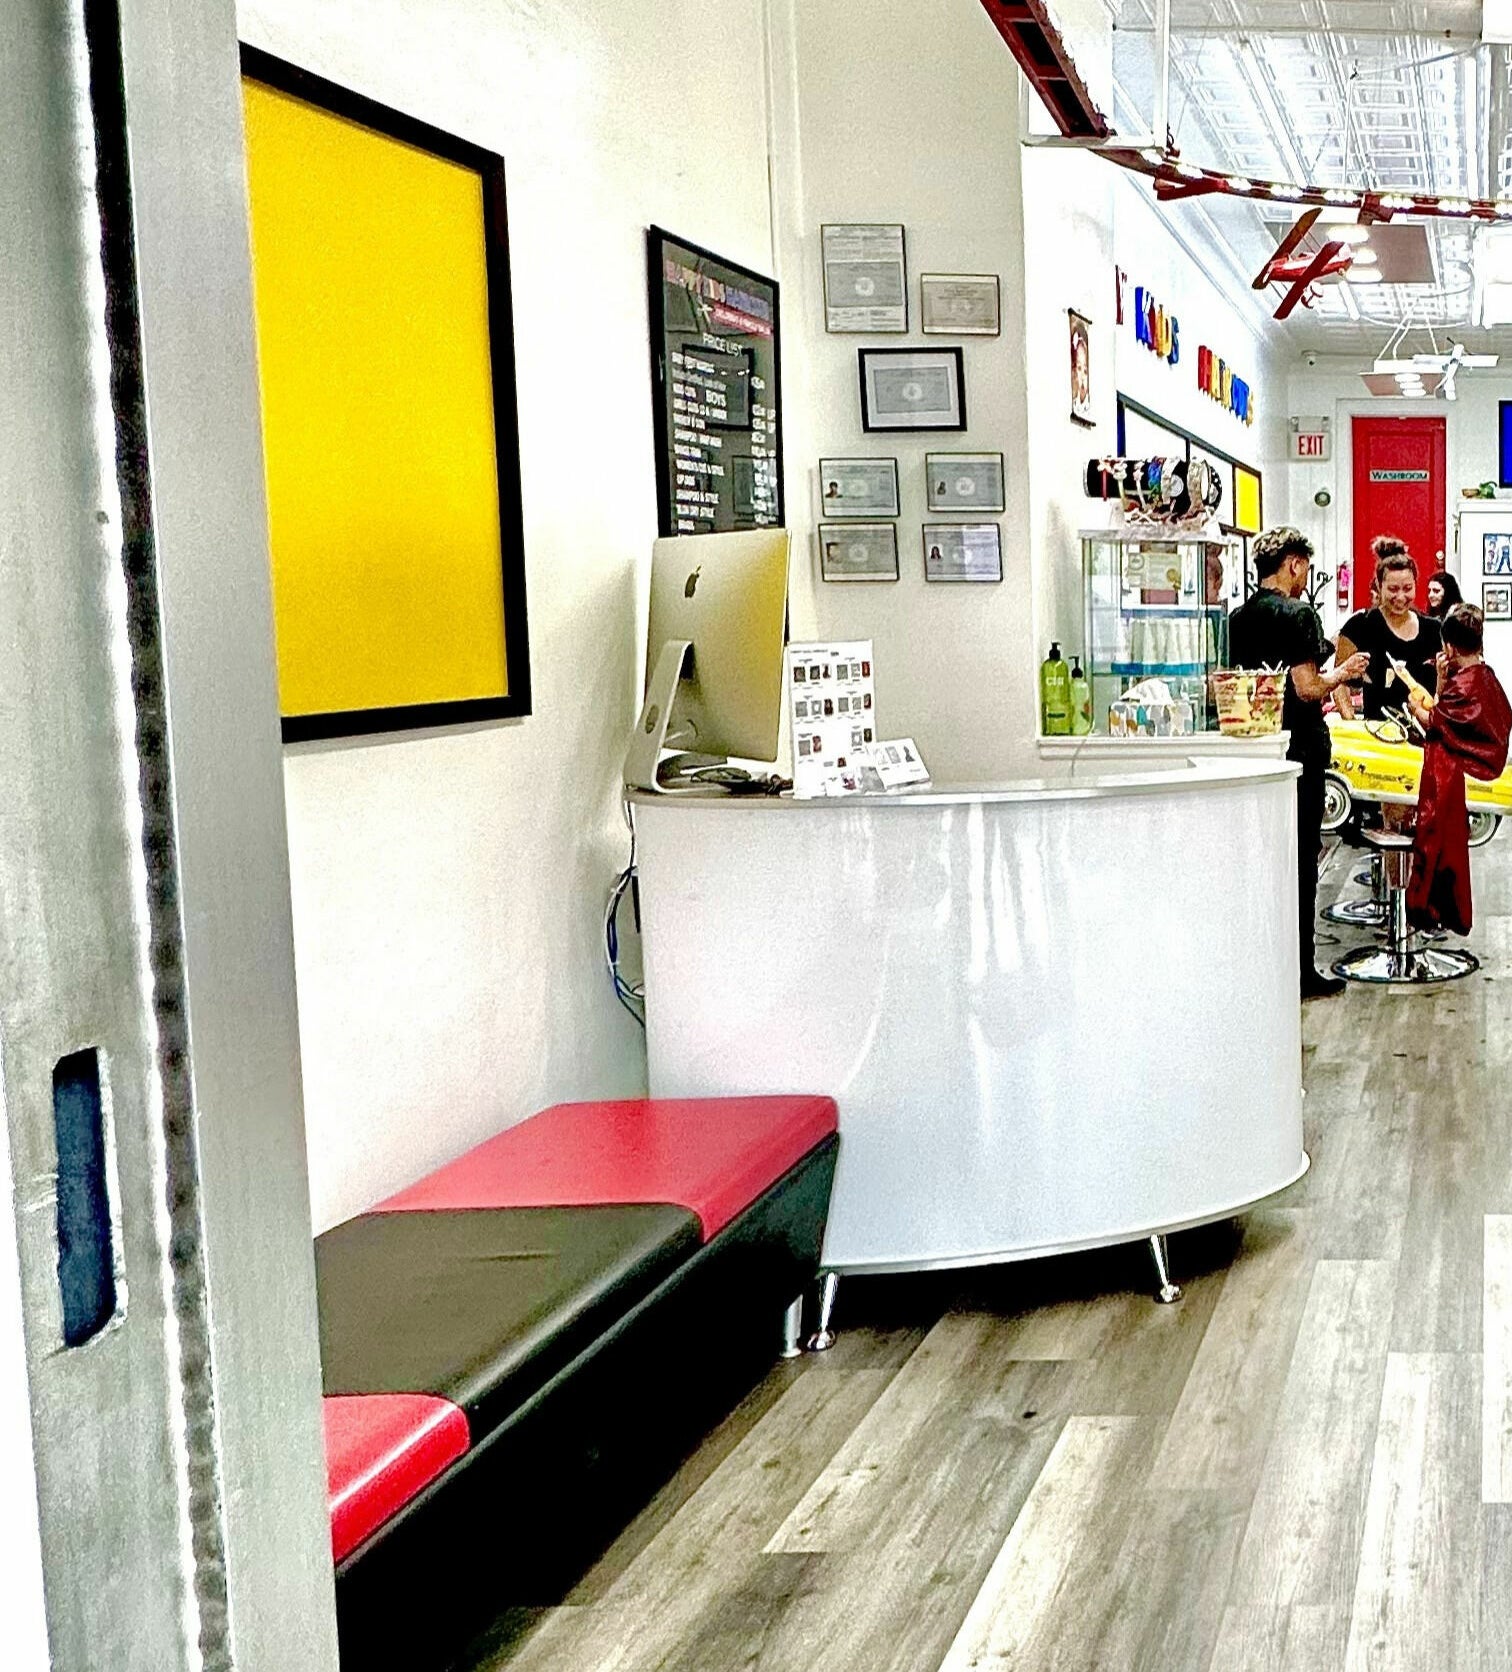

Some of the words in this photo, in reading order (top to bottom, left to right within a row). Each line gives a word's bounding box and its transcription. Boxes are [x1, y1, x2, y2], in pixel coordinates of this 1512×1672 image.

[1135, 286, 1180, 366] KIDS
[702, 332, 726, 352] PRICE
[726, 341, 744, 357] LIST
[705, 389, 727, 408] BOYS
[1298, 435, 1324, 455] EXIT
[1372, 471, 1427, 480] WASHROOM
